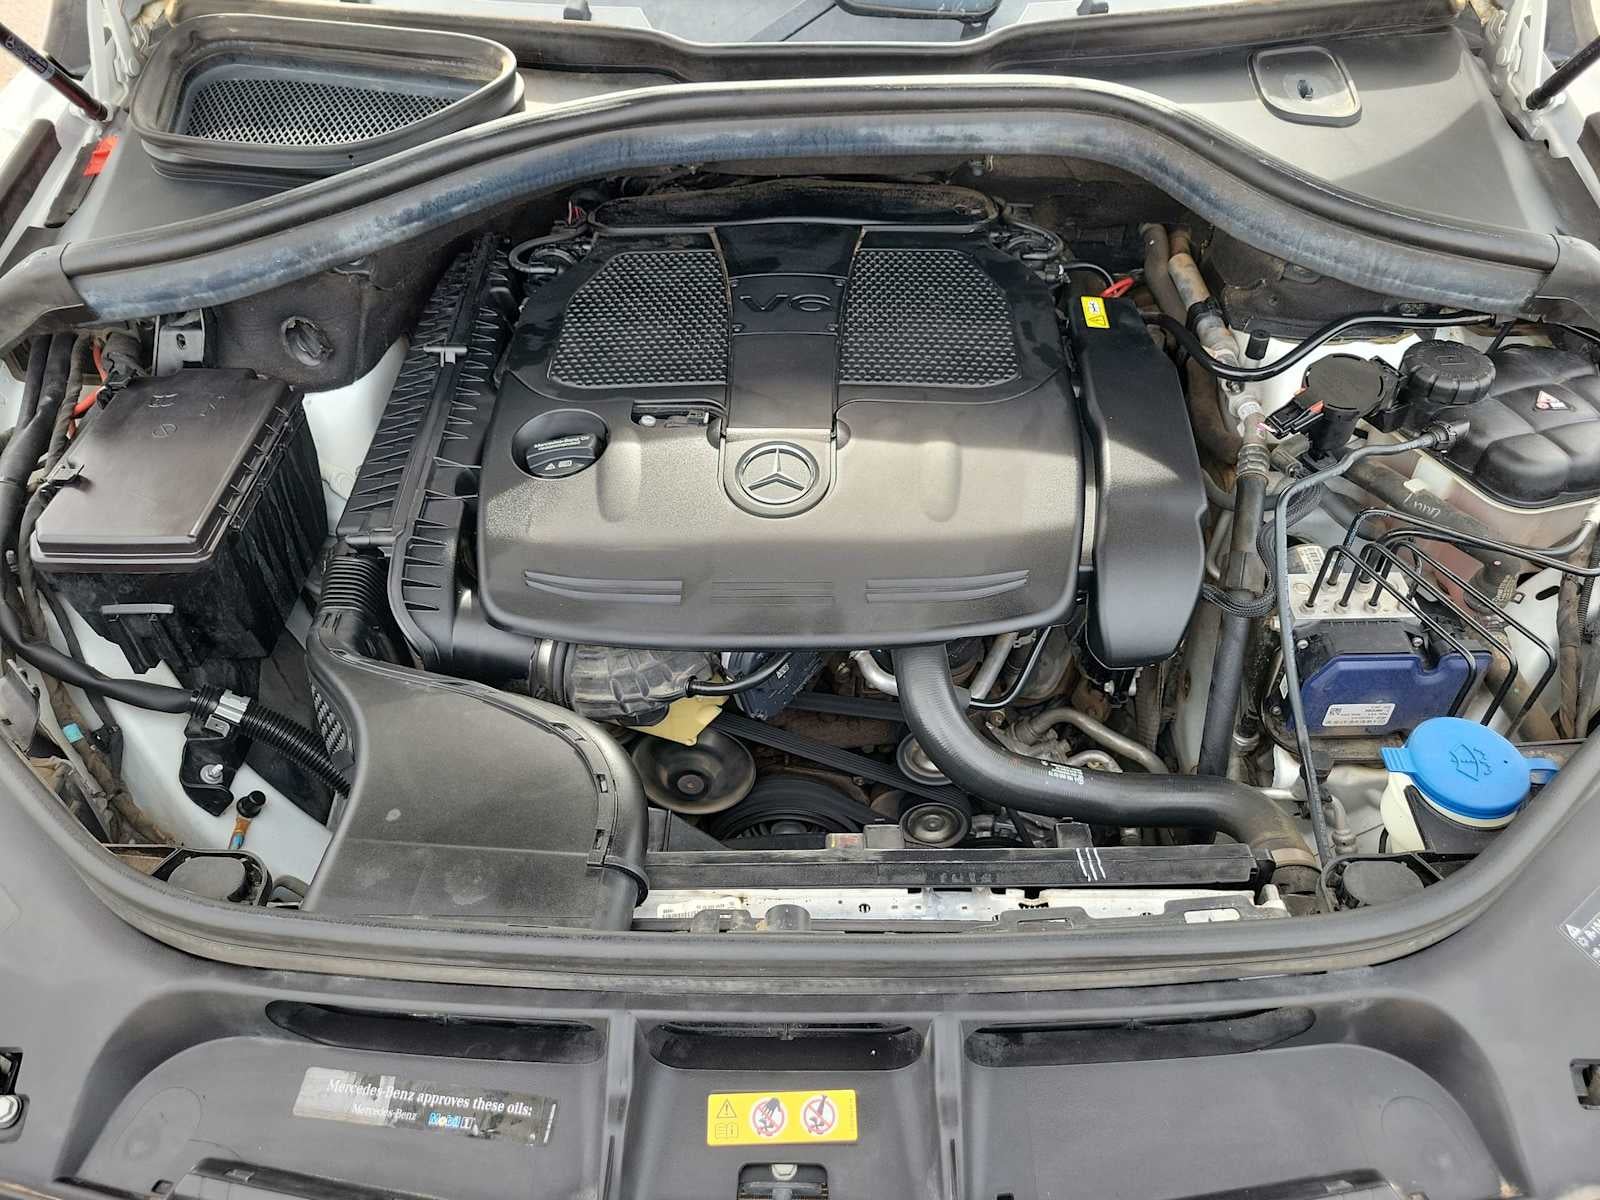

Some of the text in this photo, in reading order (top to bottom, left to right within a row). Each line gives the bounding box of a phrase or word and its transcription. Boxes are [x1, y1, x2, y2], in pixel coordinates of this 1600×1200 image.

[739, 293, 832, 312] V6
[327, 1079, 533, 1116] Mercedes-Benz approves these oils:
[351, 1103, 418, 1121] Mercedes-Benz
[428, 1111, 461, 1129] Mobil
